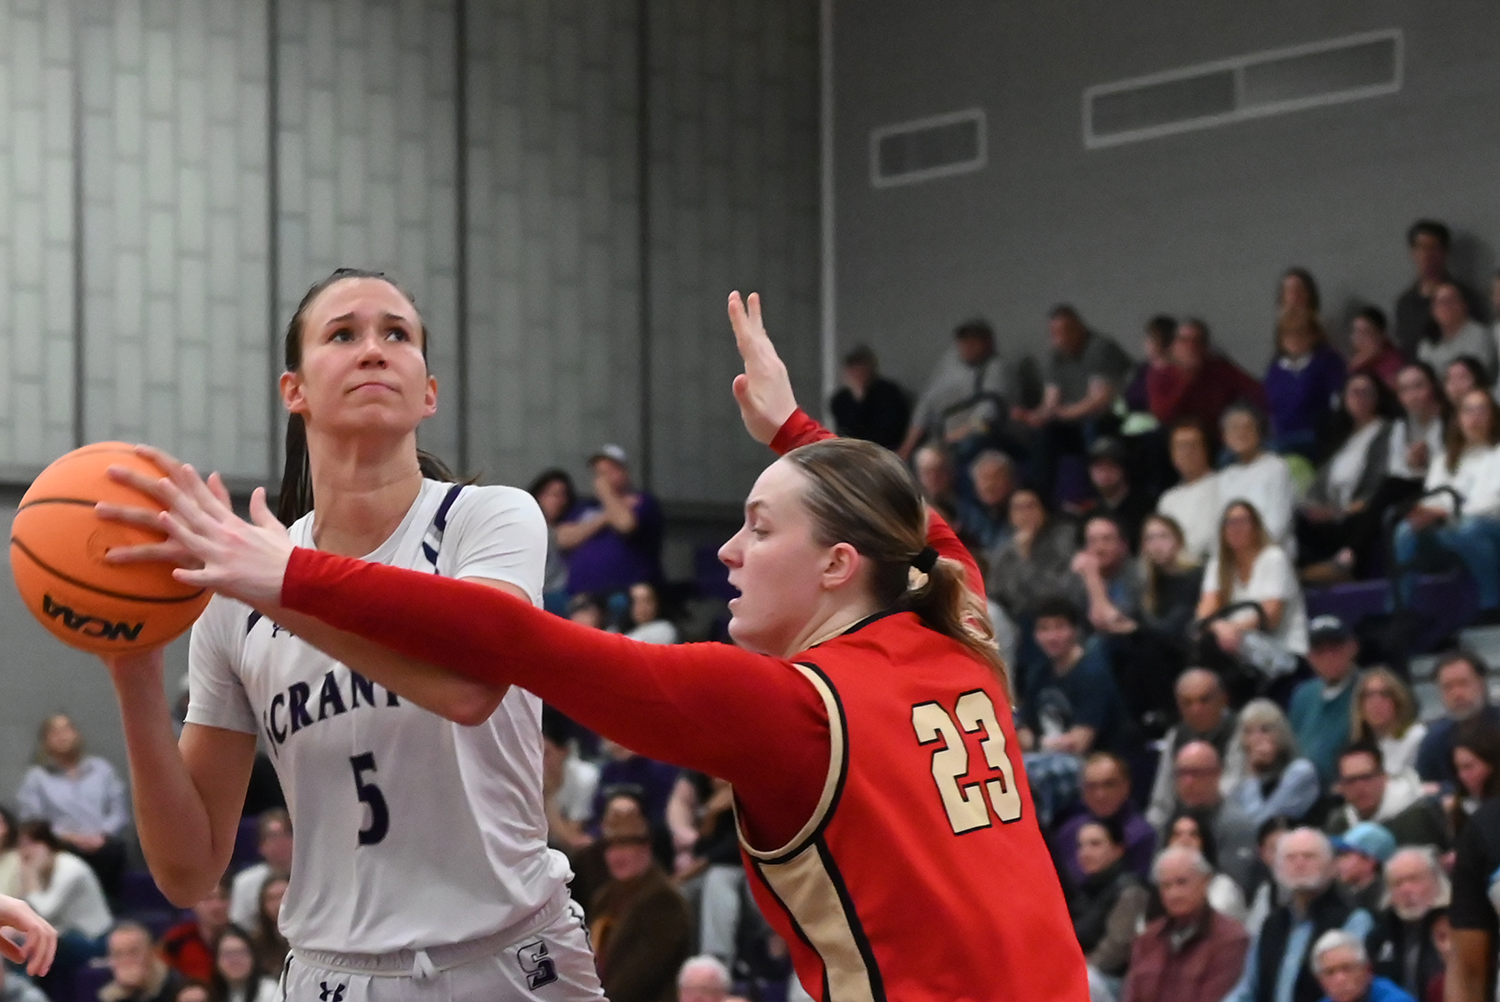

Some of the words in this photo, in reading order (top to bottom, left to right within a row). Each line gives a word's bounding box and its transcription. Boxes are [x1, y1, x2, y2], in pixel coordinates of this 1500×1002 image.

[42, 594, 145, 641] NCAA
[349, 751, 391, 845] 5
[911, 688, 1023, 835] 23
